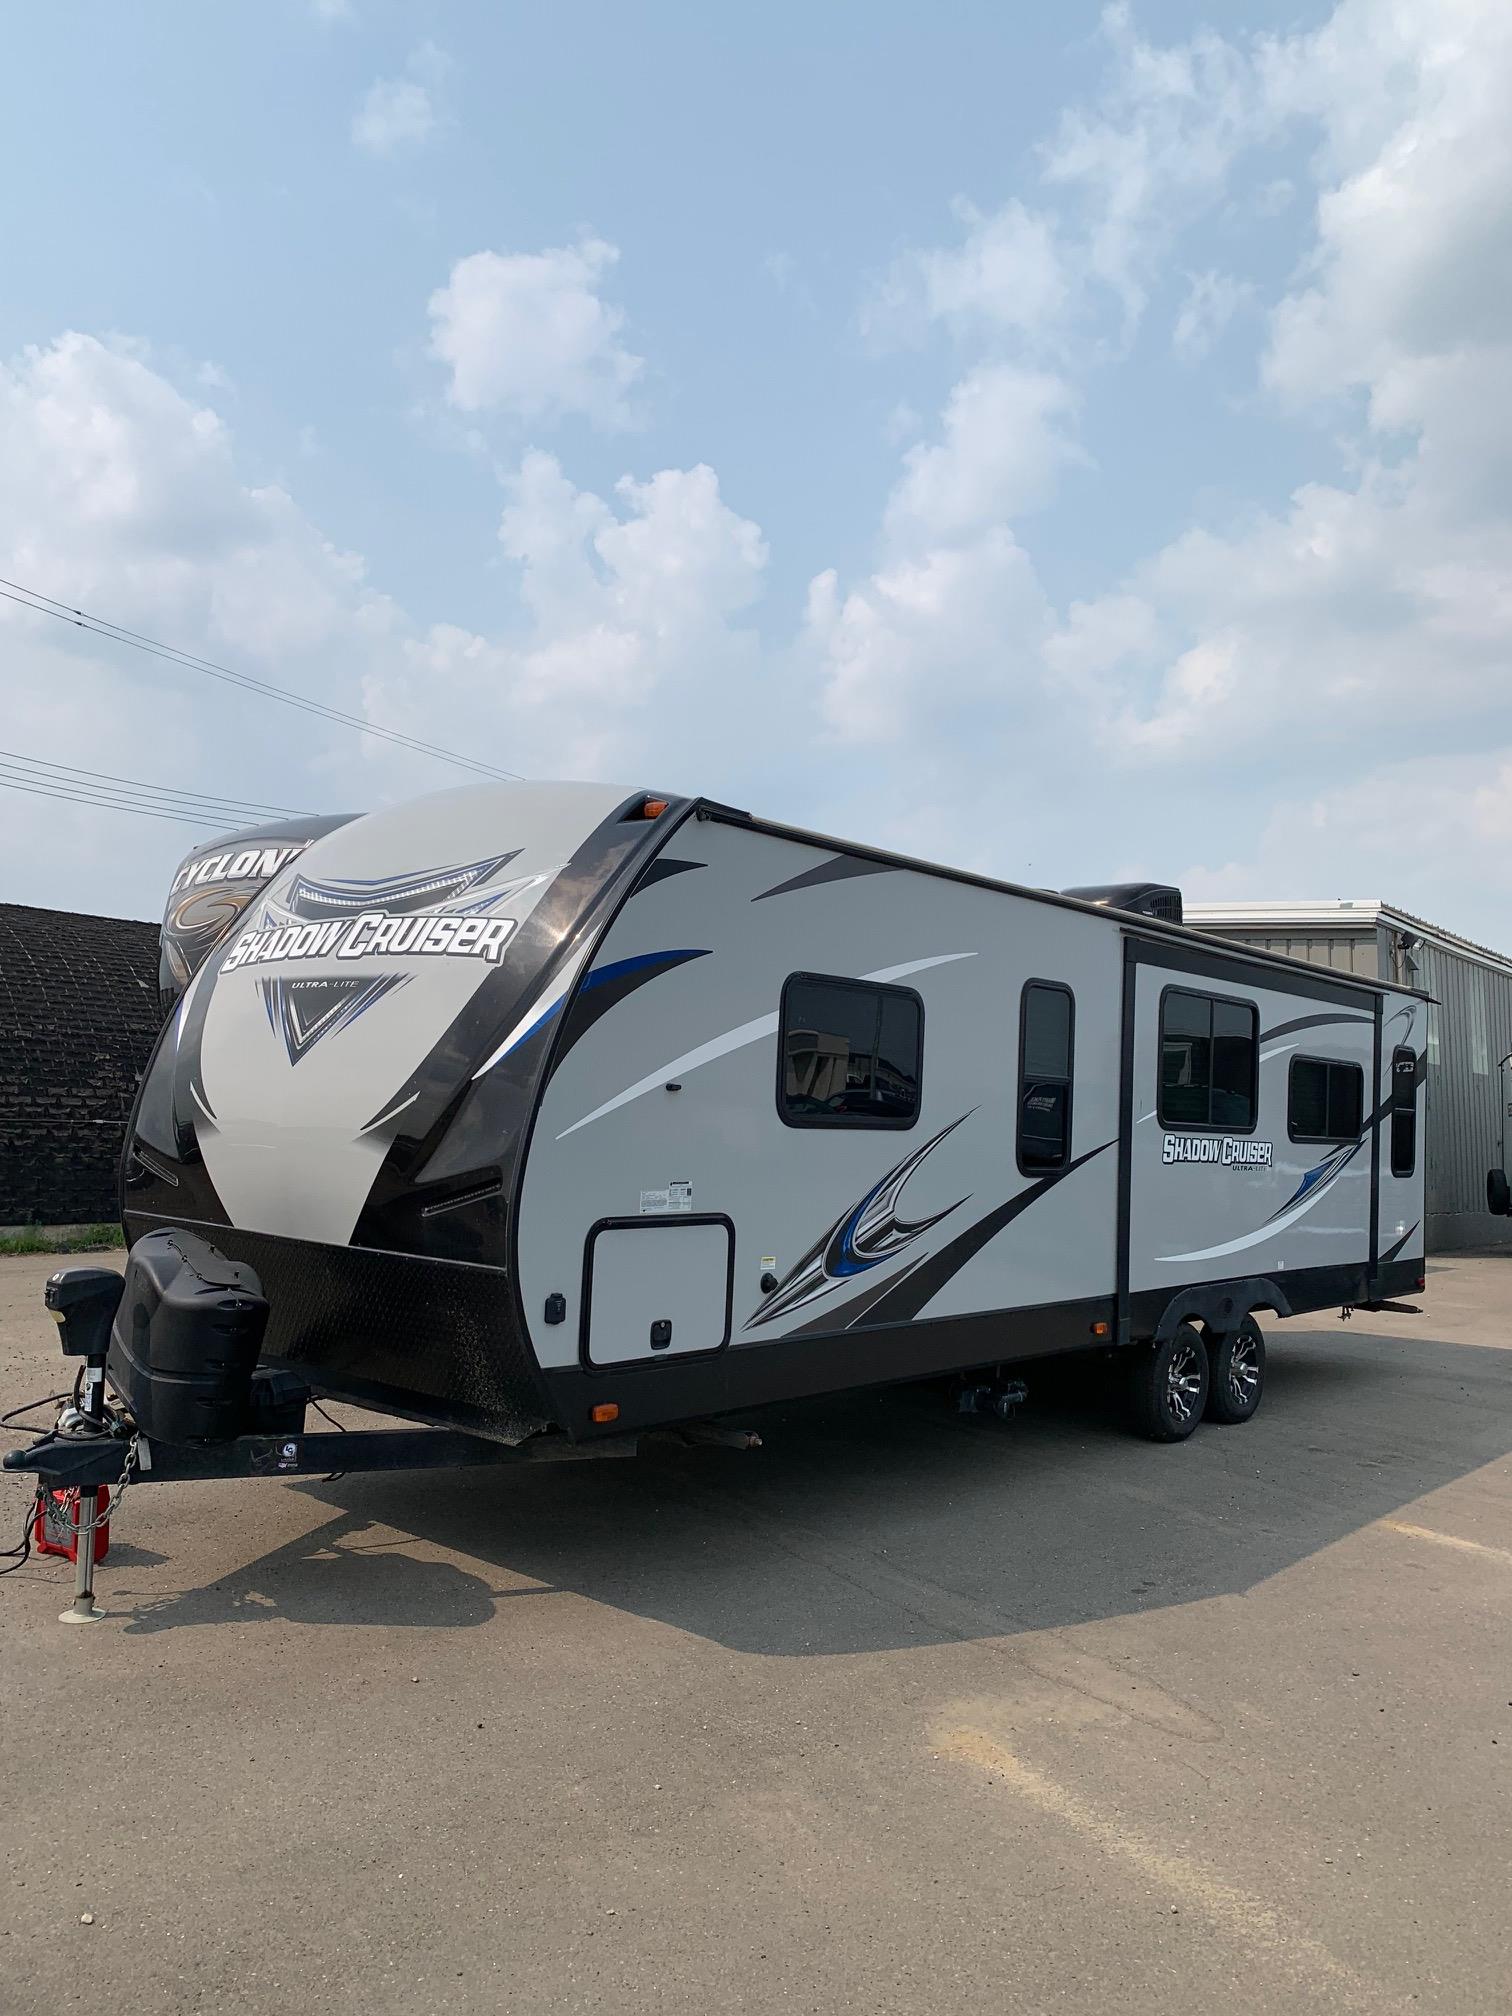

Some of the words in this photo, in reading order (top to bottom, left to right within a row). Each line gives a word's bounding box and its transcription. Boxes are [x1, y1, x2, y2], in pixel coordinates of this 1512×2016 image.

[219, 920, 350, 973] SHADOW
[338, 912, 516, 963] CRUISER
[291, 980, 360, 989] ULTRA-LITE
[1163, 1133, 1221, 1164] SHADOW
[1221, 1137, 1272, 1167] CRUISER
